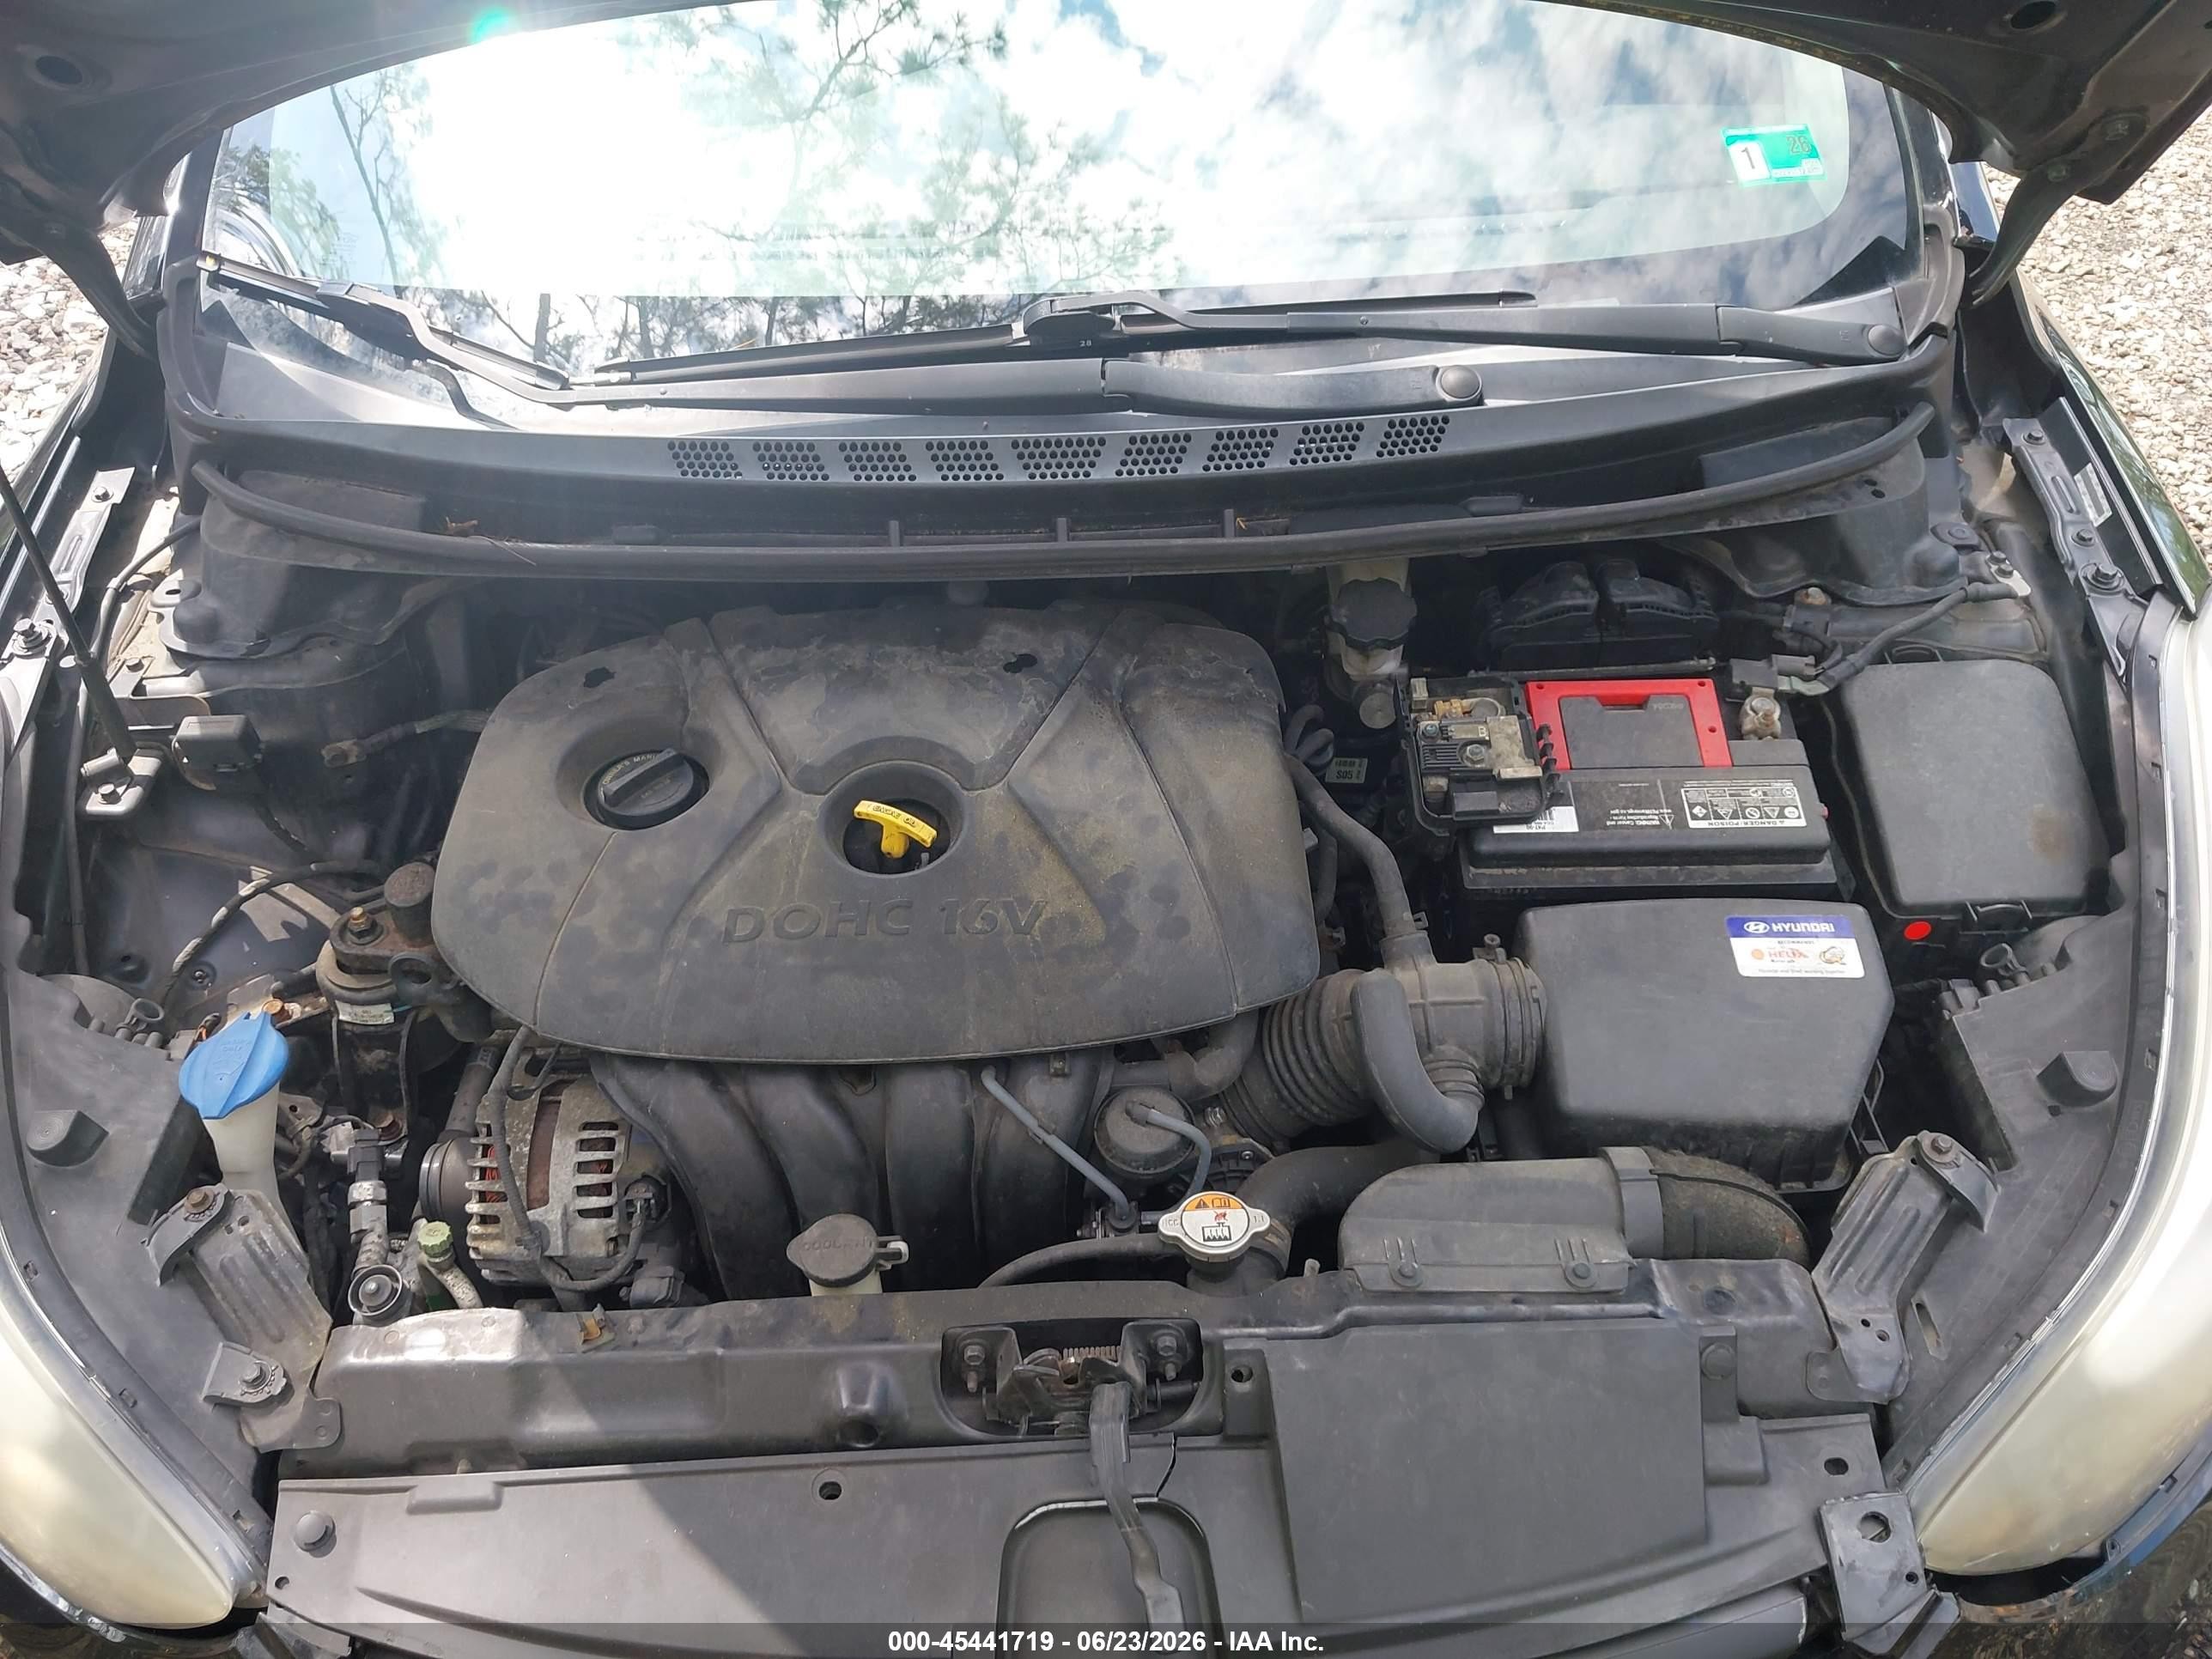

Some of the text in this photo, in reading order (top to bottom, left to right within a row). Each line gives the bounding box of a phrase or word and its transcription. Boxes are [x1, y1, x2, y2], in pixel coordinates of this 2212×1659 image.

[1786, 135, 1812, 154] 26
[1741, 147, 1755, 169] 1
[722, 898, 1048, 944] DOHC 16V
[1771, 922, 1835, 933] HYUNDAI
